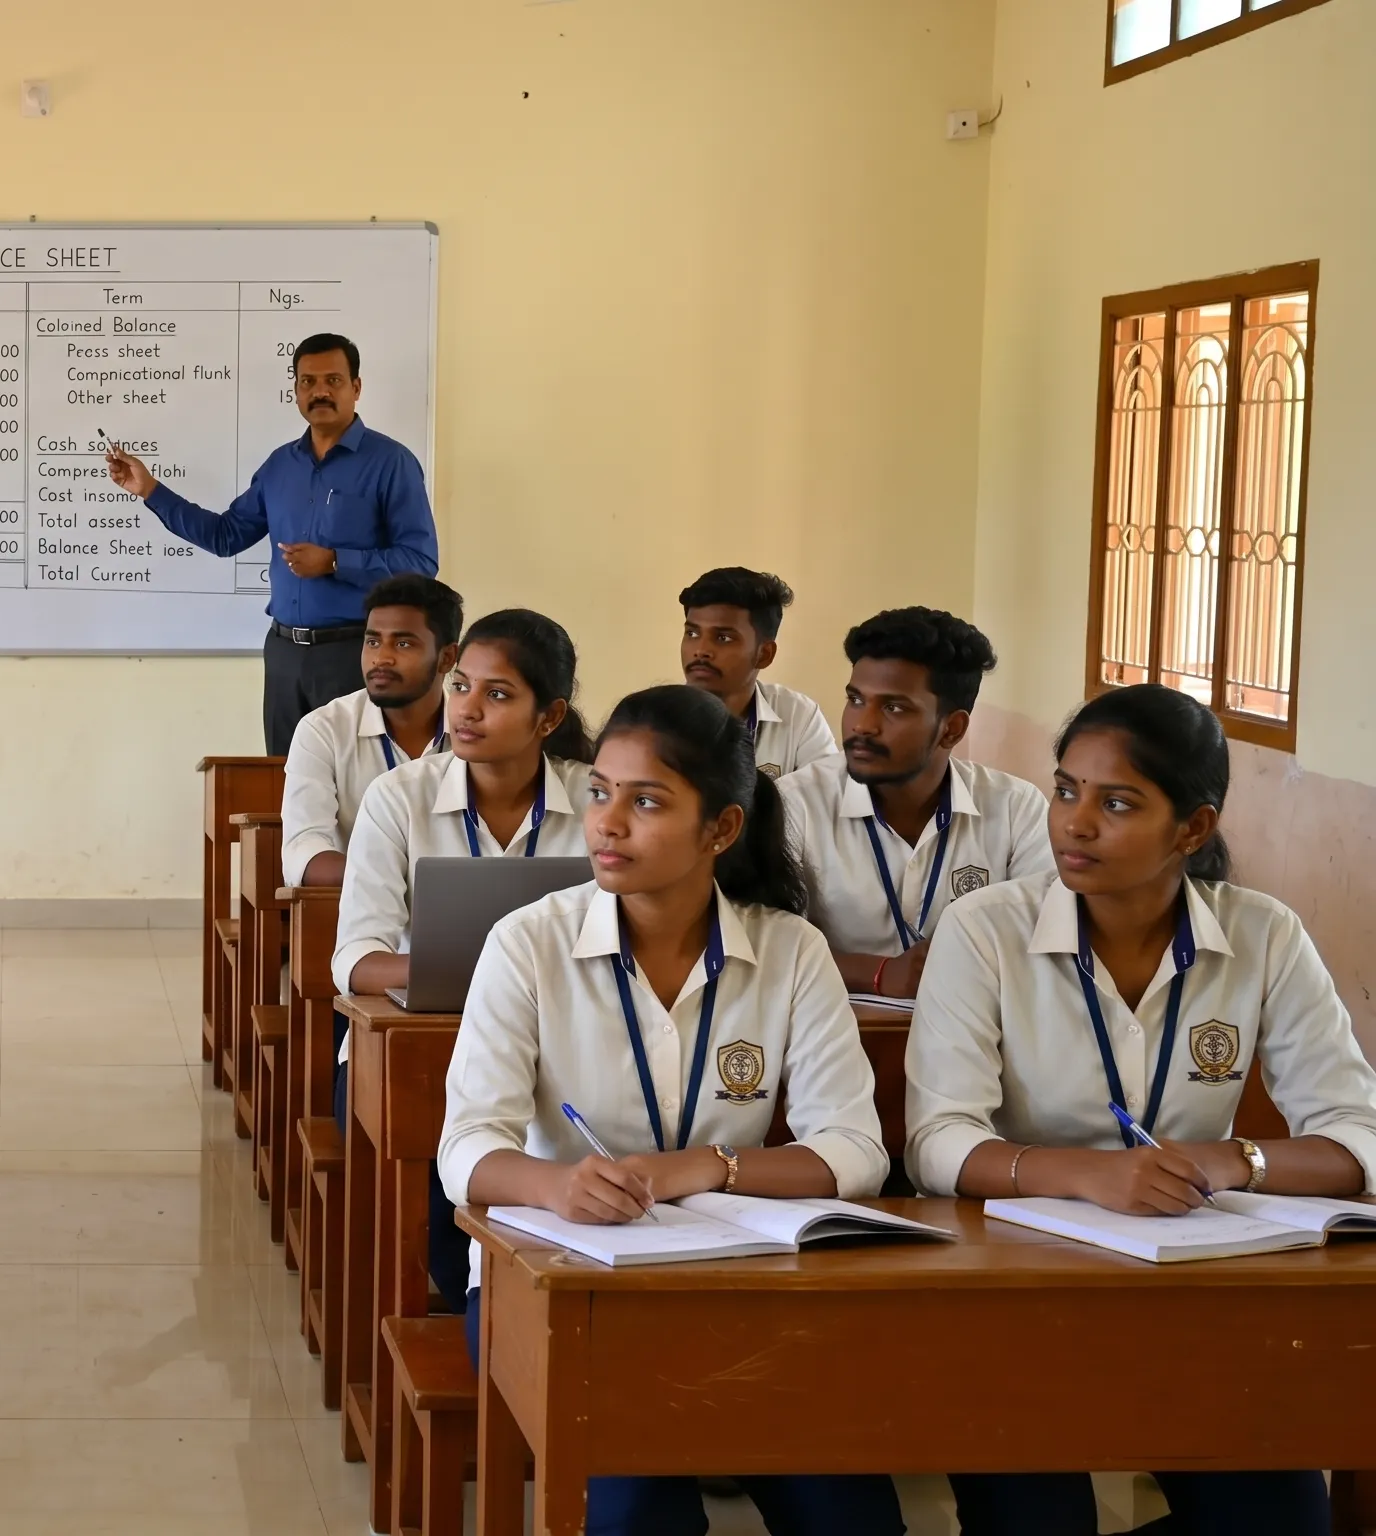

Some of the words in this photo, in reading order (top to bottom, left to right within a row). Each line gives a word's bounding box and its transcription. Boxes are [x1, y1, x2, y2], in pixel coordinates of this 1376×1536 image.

[46, 248, 117, 267] SHEET
[103, 289, 142, 304] Term
[269, 289, 305, 309] Ngs.
[118, 344, 160, 357] sheet
[193, 365, 231, 379] flunk
[68, 390, 112, 404] Other
[123, 389, 166, 404] sheet
[38, 513, 76, 528] Total
[89, 514, 140, 528] assest
[38, 538, 98, 554] Balance
[110, 539, 152, 555] Sheet
[38, 565, 79, 581] Total
[91, 567, 151, 582] Current
